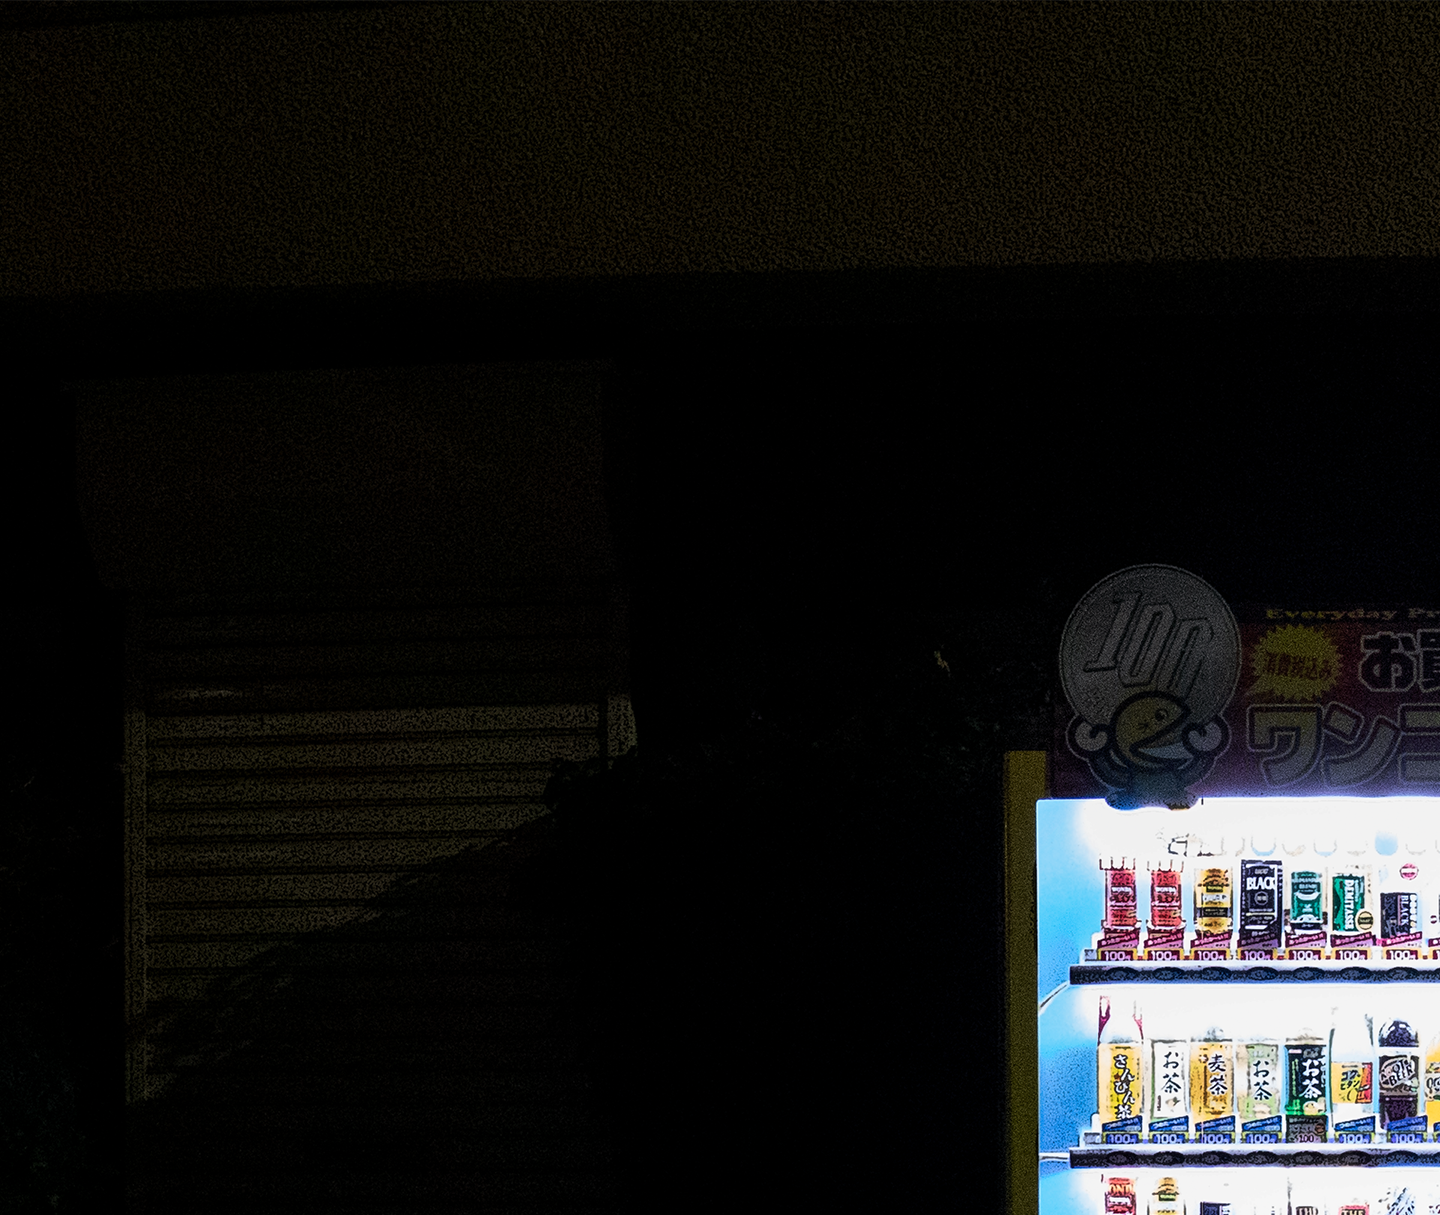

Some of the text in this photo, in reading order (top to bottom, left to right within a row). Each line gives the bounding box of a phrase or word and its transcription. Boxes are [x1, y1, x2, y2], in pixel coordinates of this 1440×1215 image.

[1266, 607, 1398, 622] Everyday
[1400, 894, 1409, 926] BLACK
[1160, 1051, 1182, 1094] お茶
[1207, 1054, 1229, 1096] 麦茶
[1252, 1059, 1273, 1101] お茶
[1299, 1058, 1322, 1099] お茶
